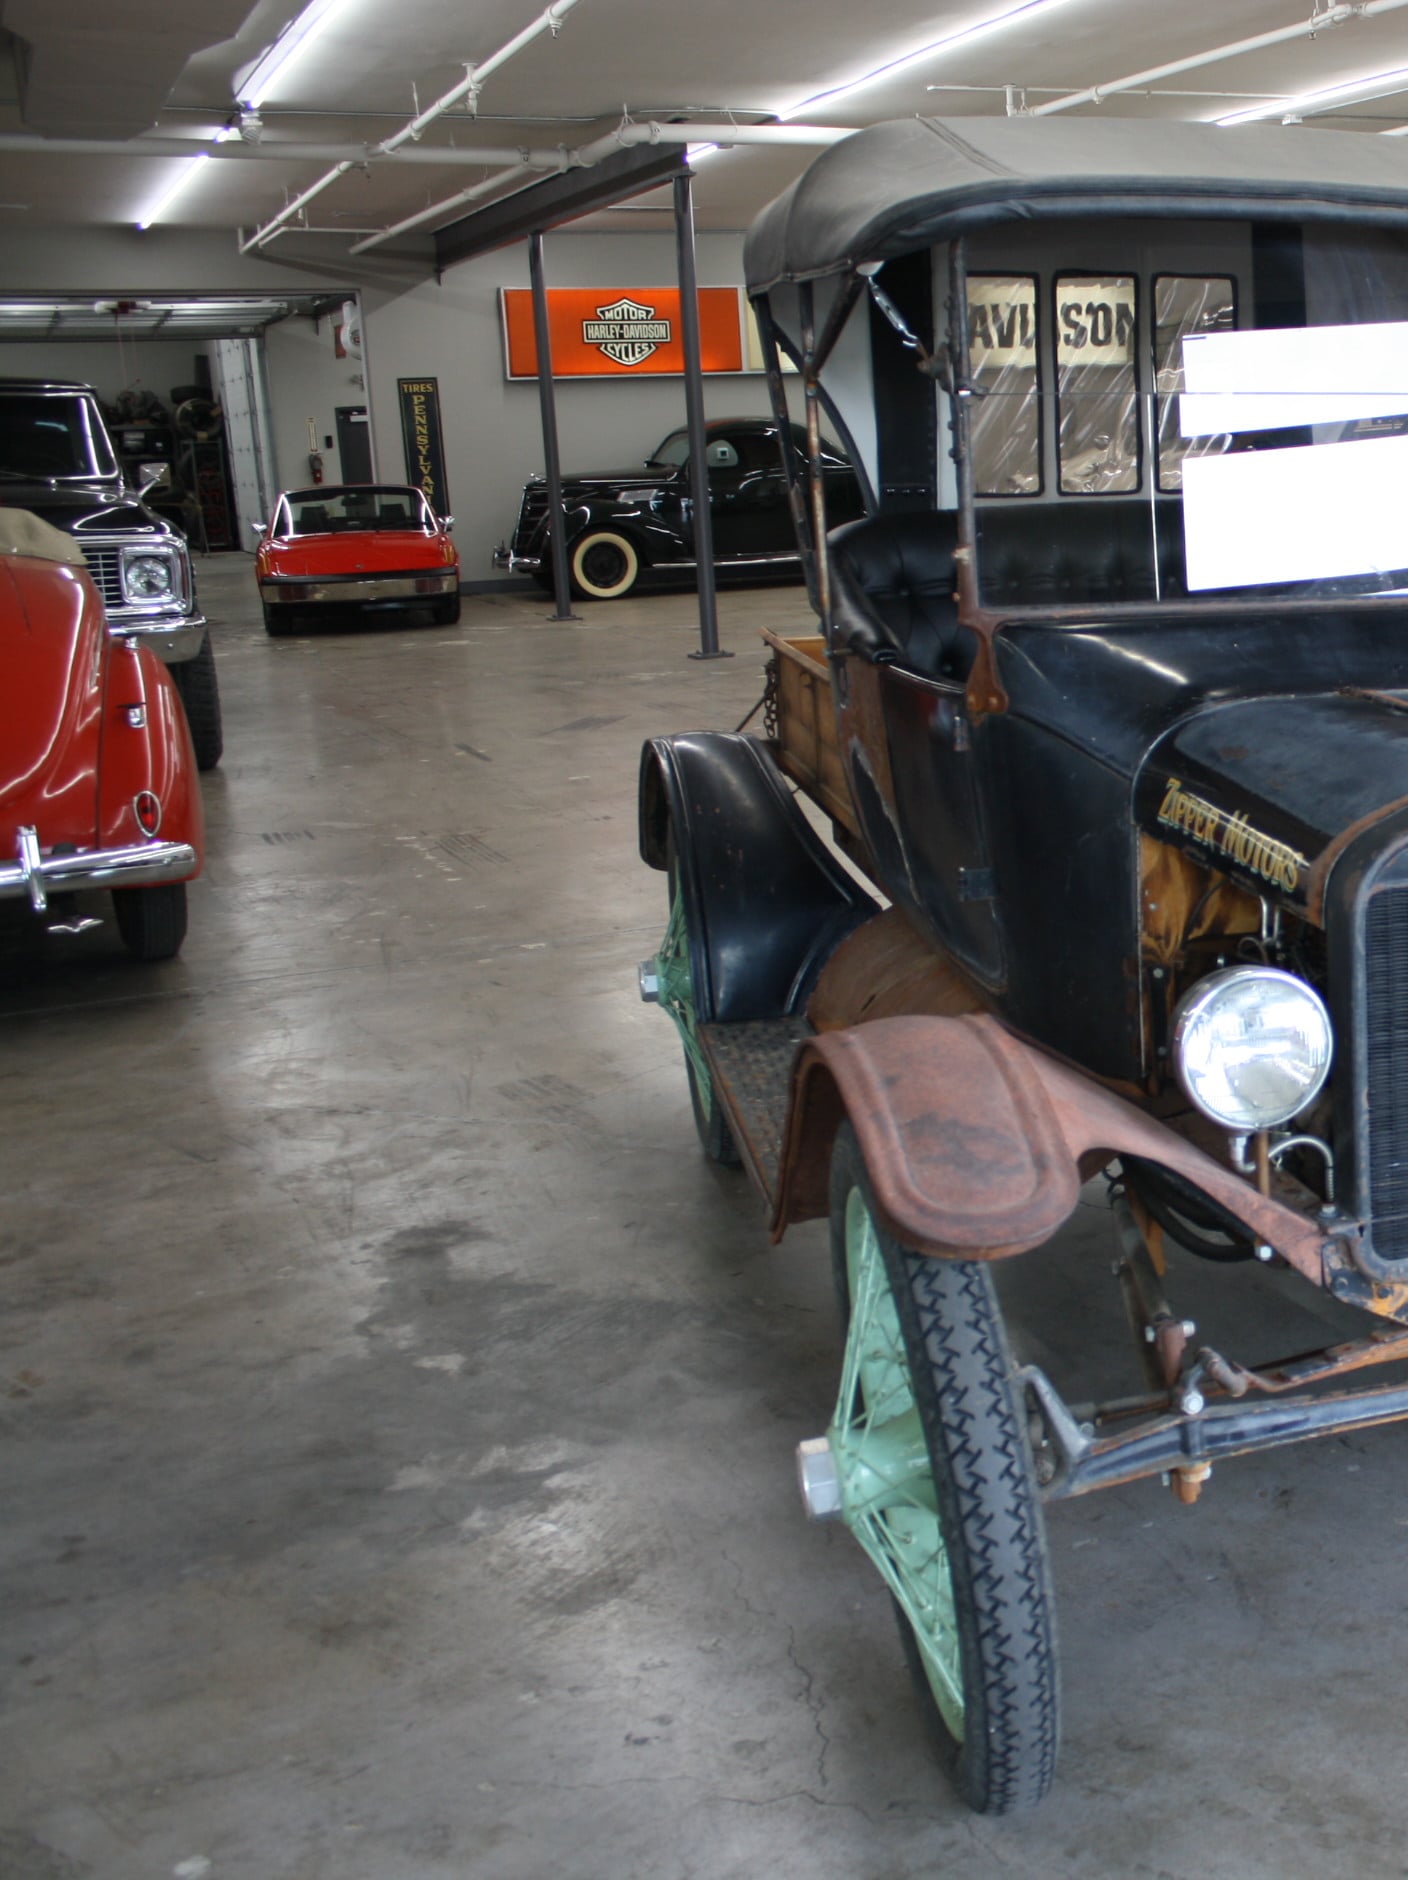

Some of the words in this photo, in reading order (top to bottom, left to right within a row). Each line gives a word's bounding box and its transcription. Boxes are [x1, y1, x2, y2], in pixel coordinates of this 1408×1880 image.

[604, 303, 647, 320] MOTOR
[587, 324, 667, 339] HARLEY-DAVIDSON
[606, 343, 650, 362] CYCLES
[402, 383, 434, 393] TIRES
